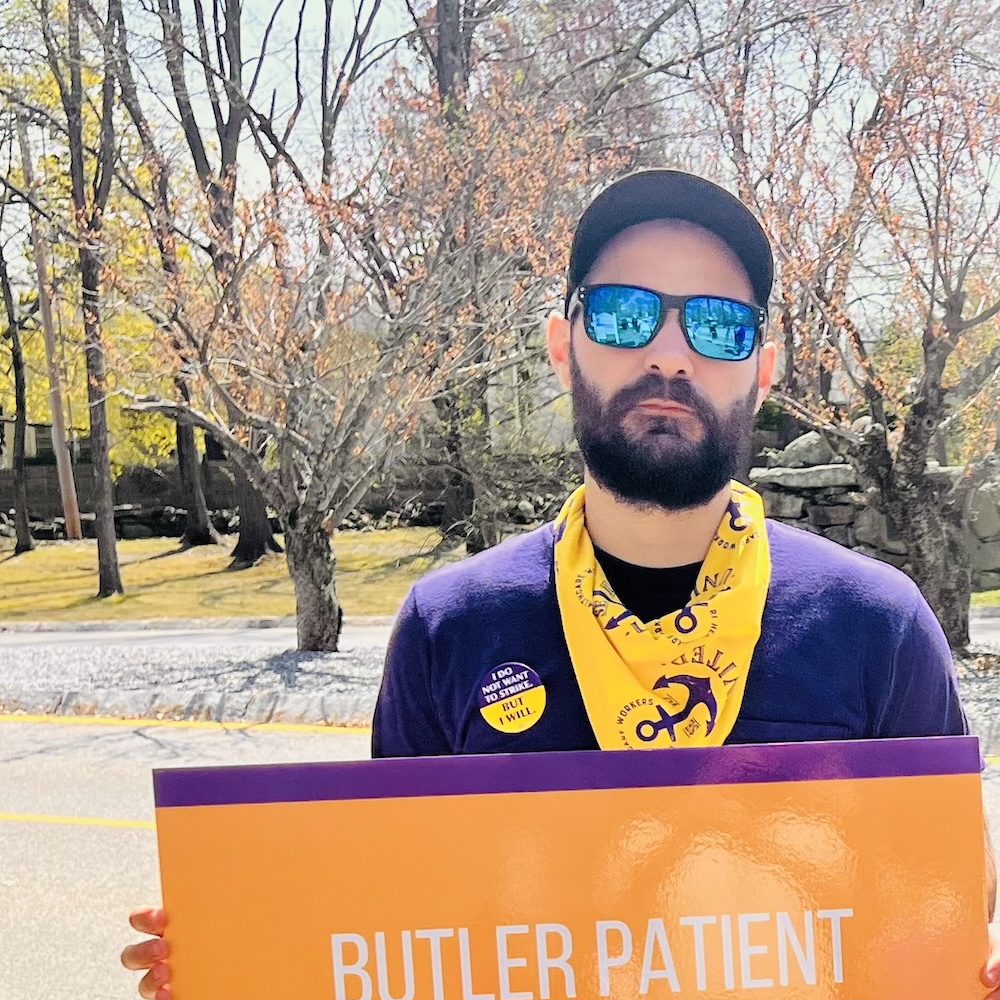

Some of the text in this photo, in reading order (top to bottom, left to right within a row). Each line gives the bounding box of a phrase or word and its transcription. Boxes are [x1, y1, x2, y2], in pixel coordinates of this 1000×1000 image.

[491, 667, 513, 681] I DO
[481, 670, 529, 695] NOT WANT
[484, 692, 498, 703] TO
[502, 697, 523, 712] BUT
[616, 698, 653, 725] WORKERS
[499, 717, 504, 725] I
[596, 908, 853, 996] PATIENT
